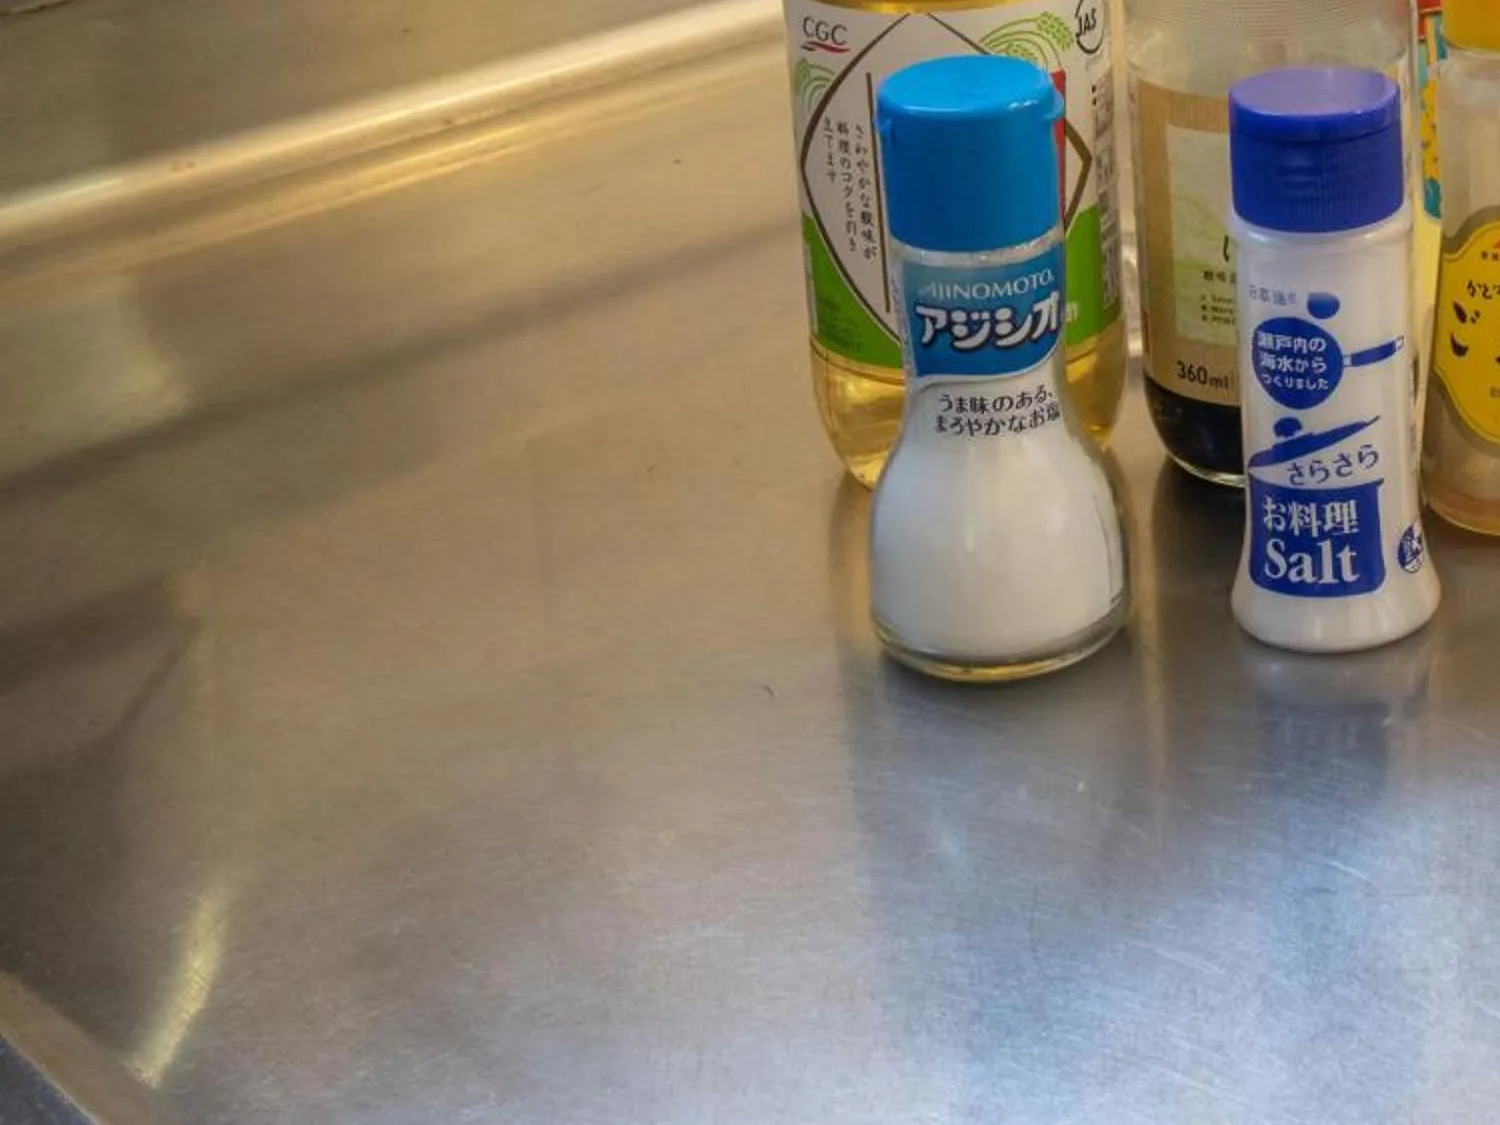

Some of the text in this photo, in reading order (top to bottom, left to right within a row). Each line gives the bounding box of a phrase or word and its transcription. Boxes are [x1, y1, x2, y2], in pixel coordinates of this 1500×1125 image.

[802, 16, 848, 46] CGC
[1077, 7, 1097, 37] JAS
[915, 291, 1060, 350] アジシオ
[1257, 331, 1327, 354] 瀬戸内の
[1260, 352, 1327, 374] 海水から
[1260, 373, 1329, 391] つくりました
[1286, 443, 1379, 486] さらさら
[1263, 496, 1360, 538] お料理
[1264, 538, 1360, 584] Salt
